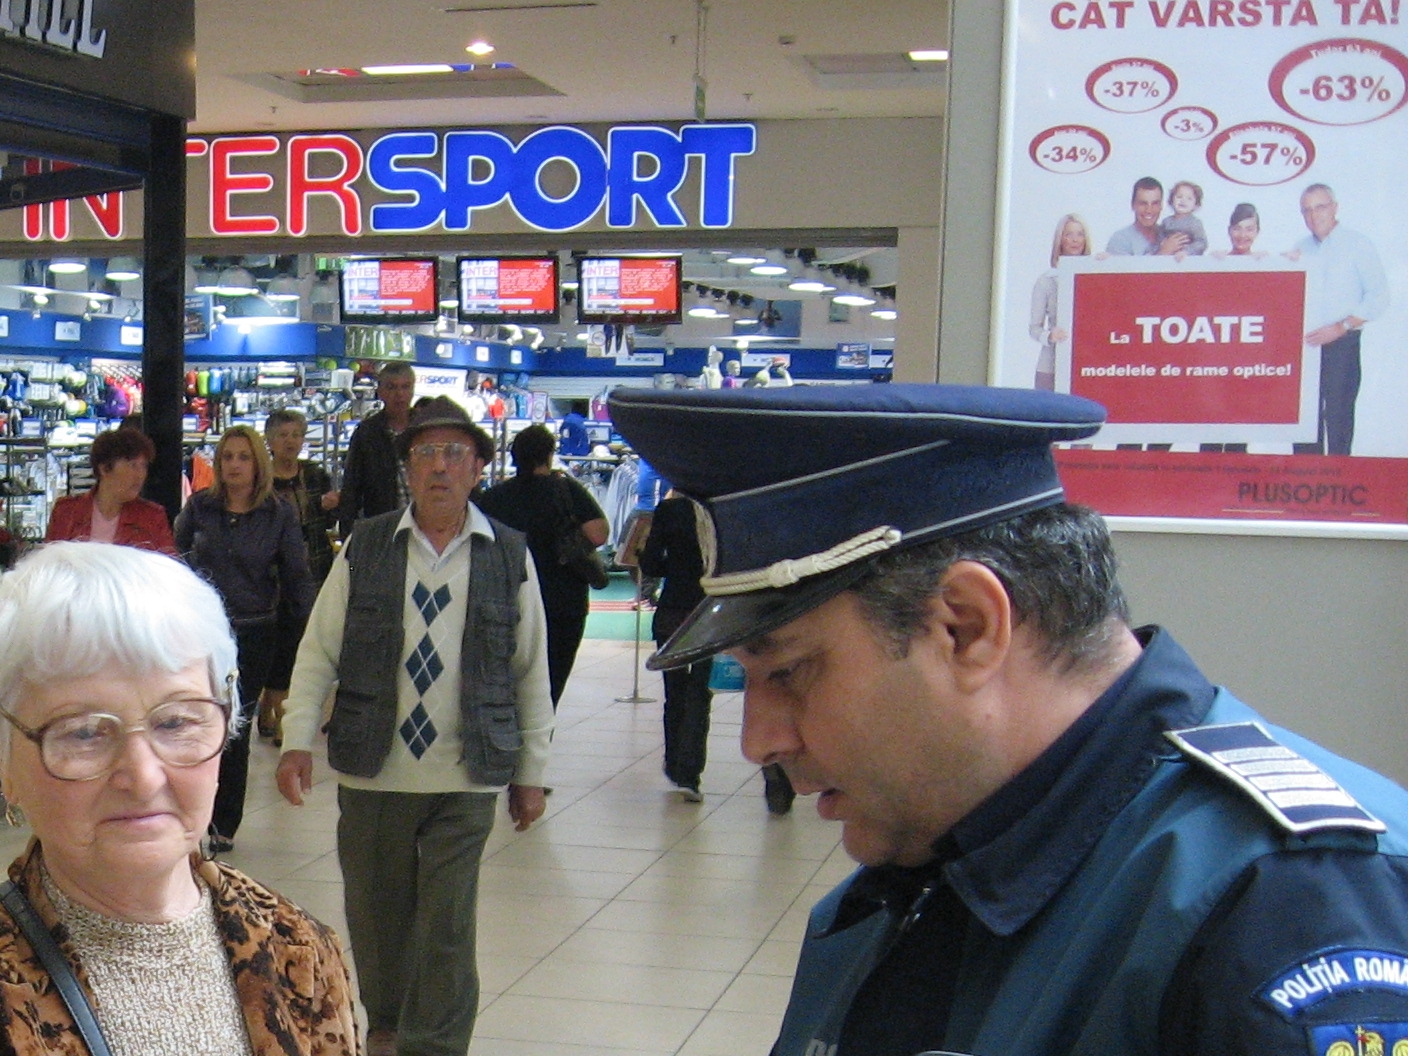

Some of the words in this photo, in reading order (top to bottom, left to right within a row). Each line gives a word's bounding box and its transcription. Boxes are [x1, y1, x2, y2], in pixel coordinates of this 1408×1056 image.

[1103, 80, 1160, 99] -37%
[1298, 75, 1392, 103] -63%
[1042, 146, 1098, 165] -34%
[1229, 143, 1304, 167] -57%
[23, 123, 757, 242] INERSPORT
[1110, 332, 1130, 345] La
[1135, 315, 1265, 345] TOATE
[1080, 363, 1156, 378] modelele
[1160, 363, 1181, 377] de
[1186, 364, 1229, 377] rame
[1233, 363, 1291, 380] optice!
[1237, 480, 1370, 506] PLUSOPTIC
